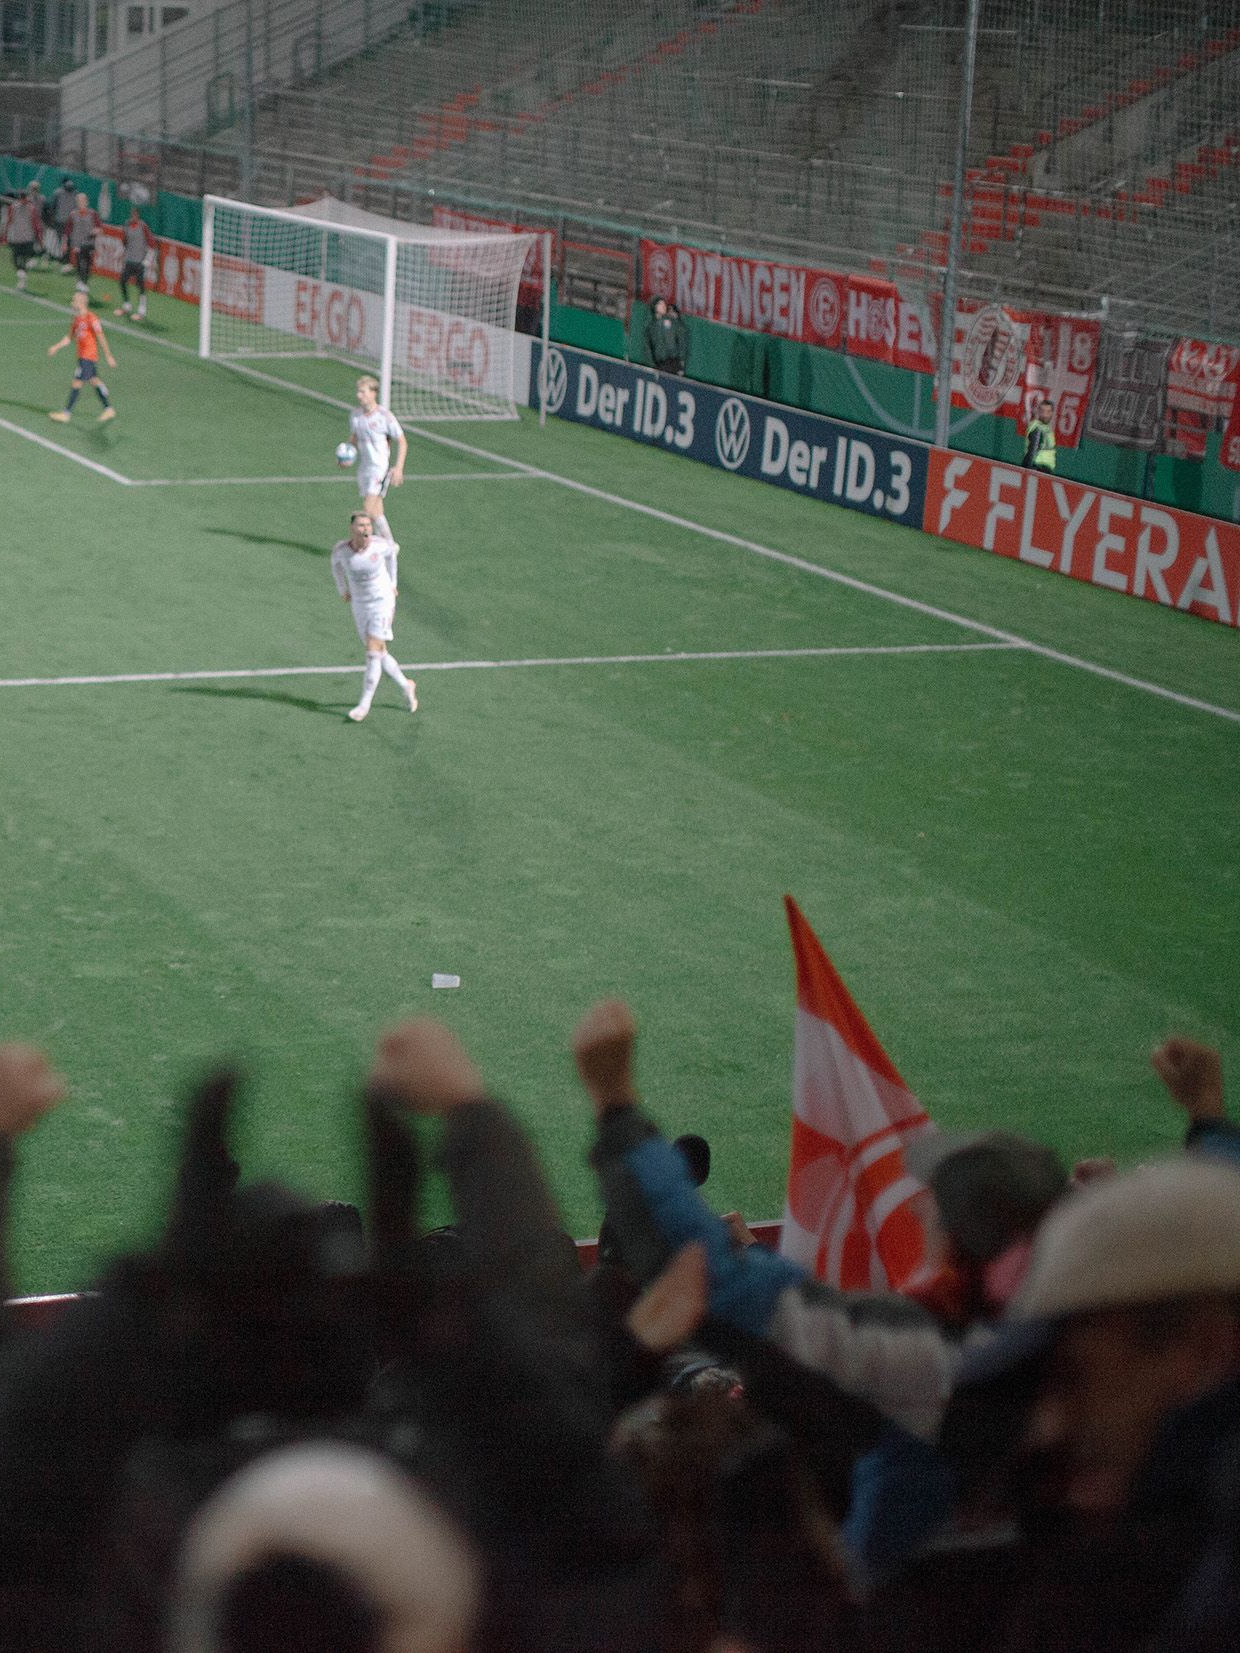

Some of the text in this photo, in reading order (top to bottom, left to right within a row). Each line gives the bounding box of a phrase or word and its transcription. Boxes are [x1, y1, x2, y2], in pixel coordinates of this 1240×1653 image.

[675, 248, 805, 338] RATINGEN
[407, 309, 489, 386] ERGO
[576, 364, 629, 427] Der
[633, 378, 696, 449] ID.3
[761, 416, 828, 488] Der
[833, 435, 913, 516] ID.3
[983, 466, 1240, 628] FLYERA
